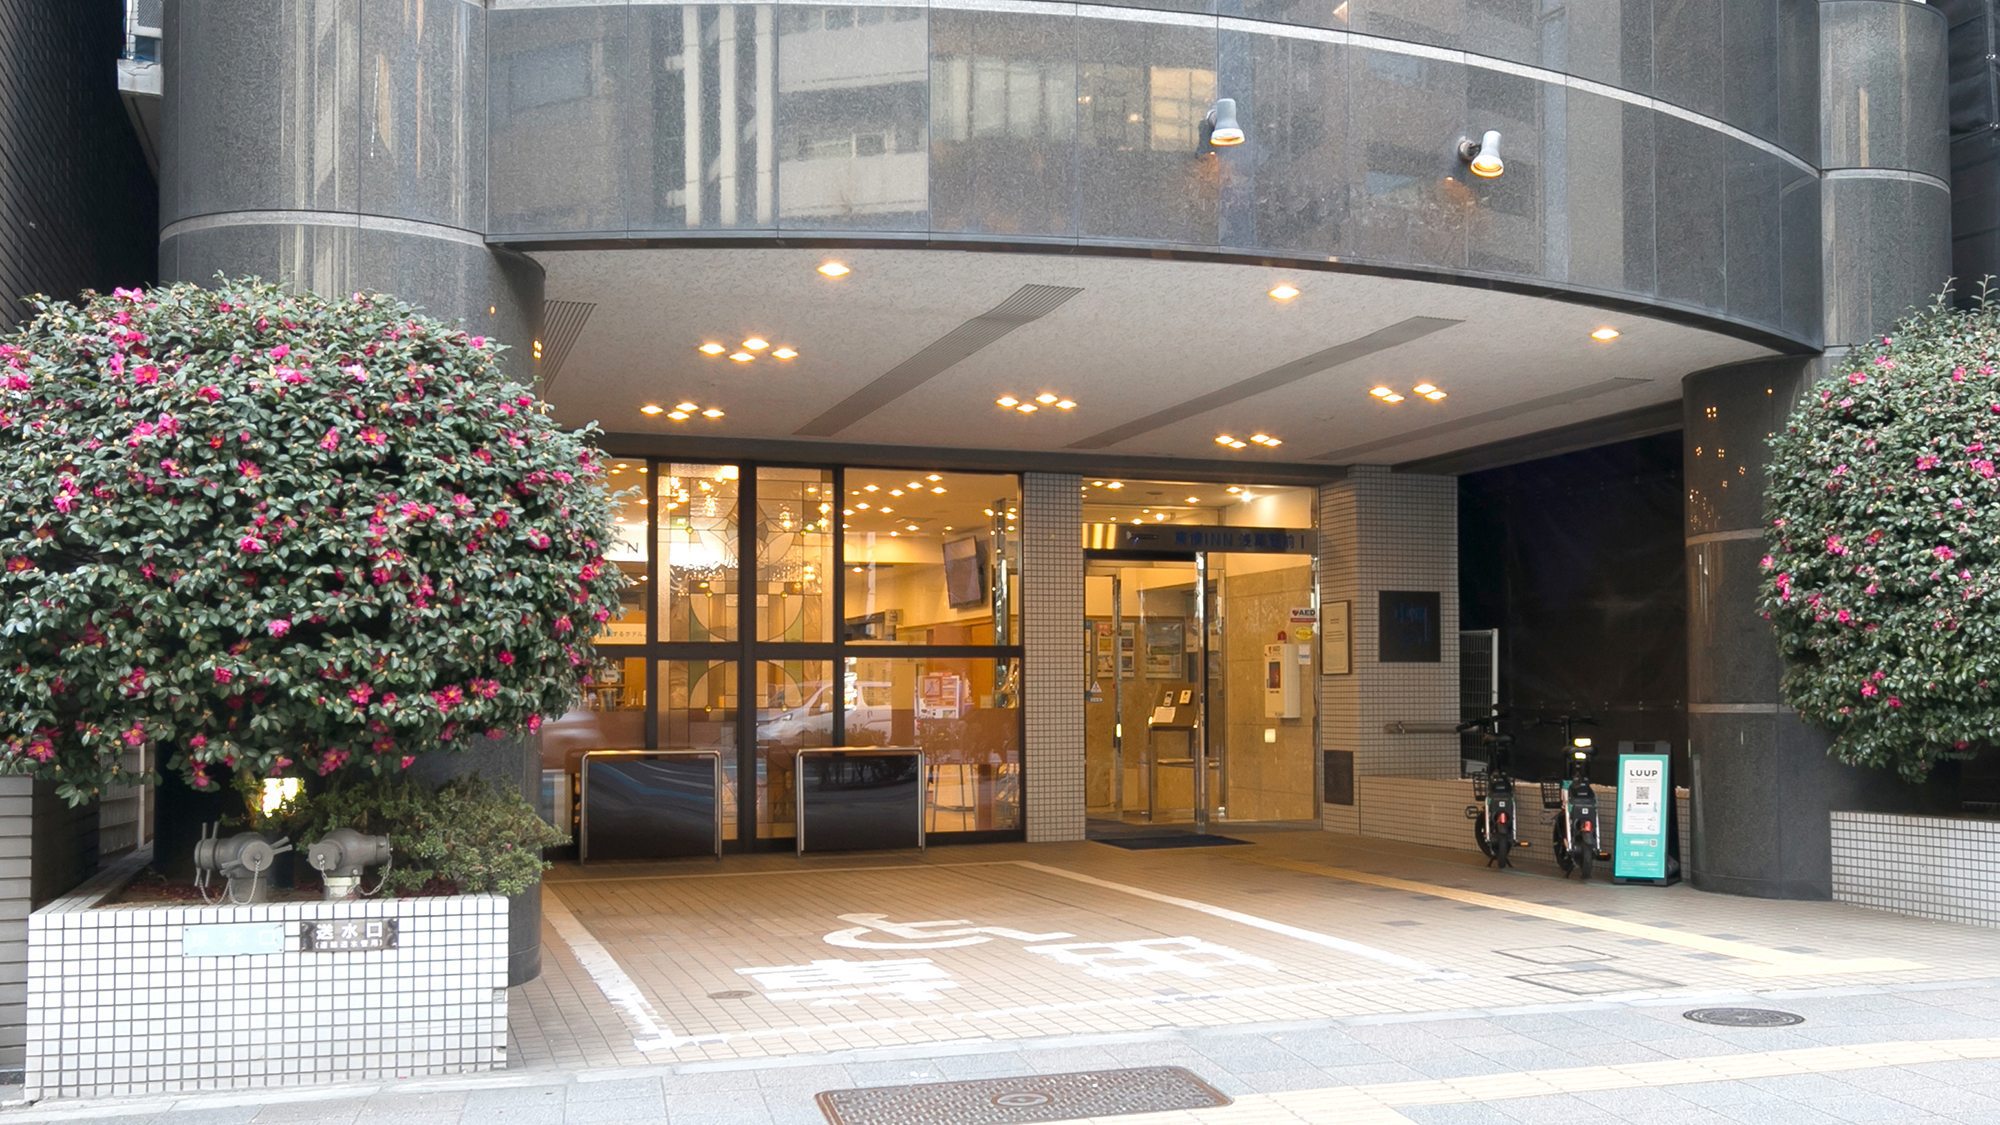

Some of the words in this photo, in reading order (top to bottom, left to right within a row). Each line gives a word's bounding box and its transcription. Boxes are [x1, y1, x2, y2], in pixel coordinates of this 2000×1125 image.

[1629, 769, 1659, 777] LUUP
[316, 921, 383, 940] 送水口
